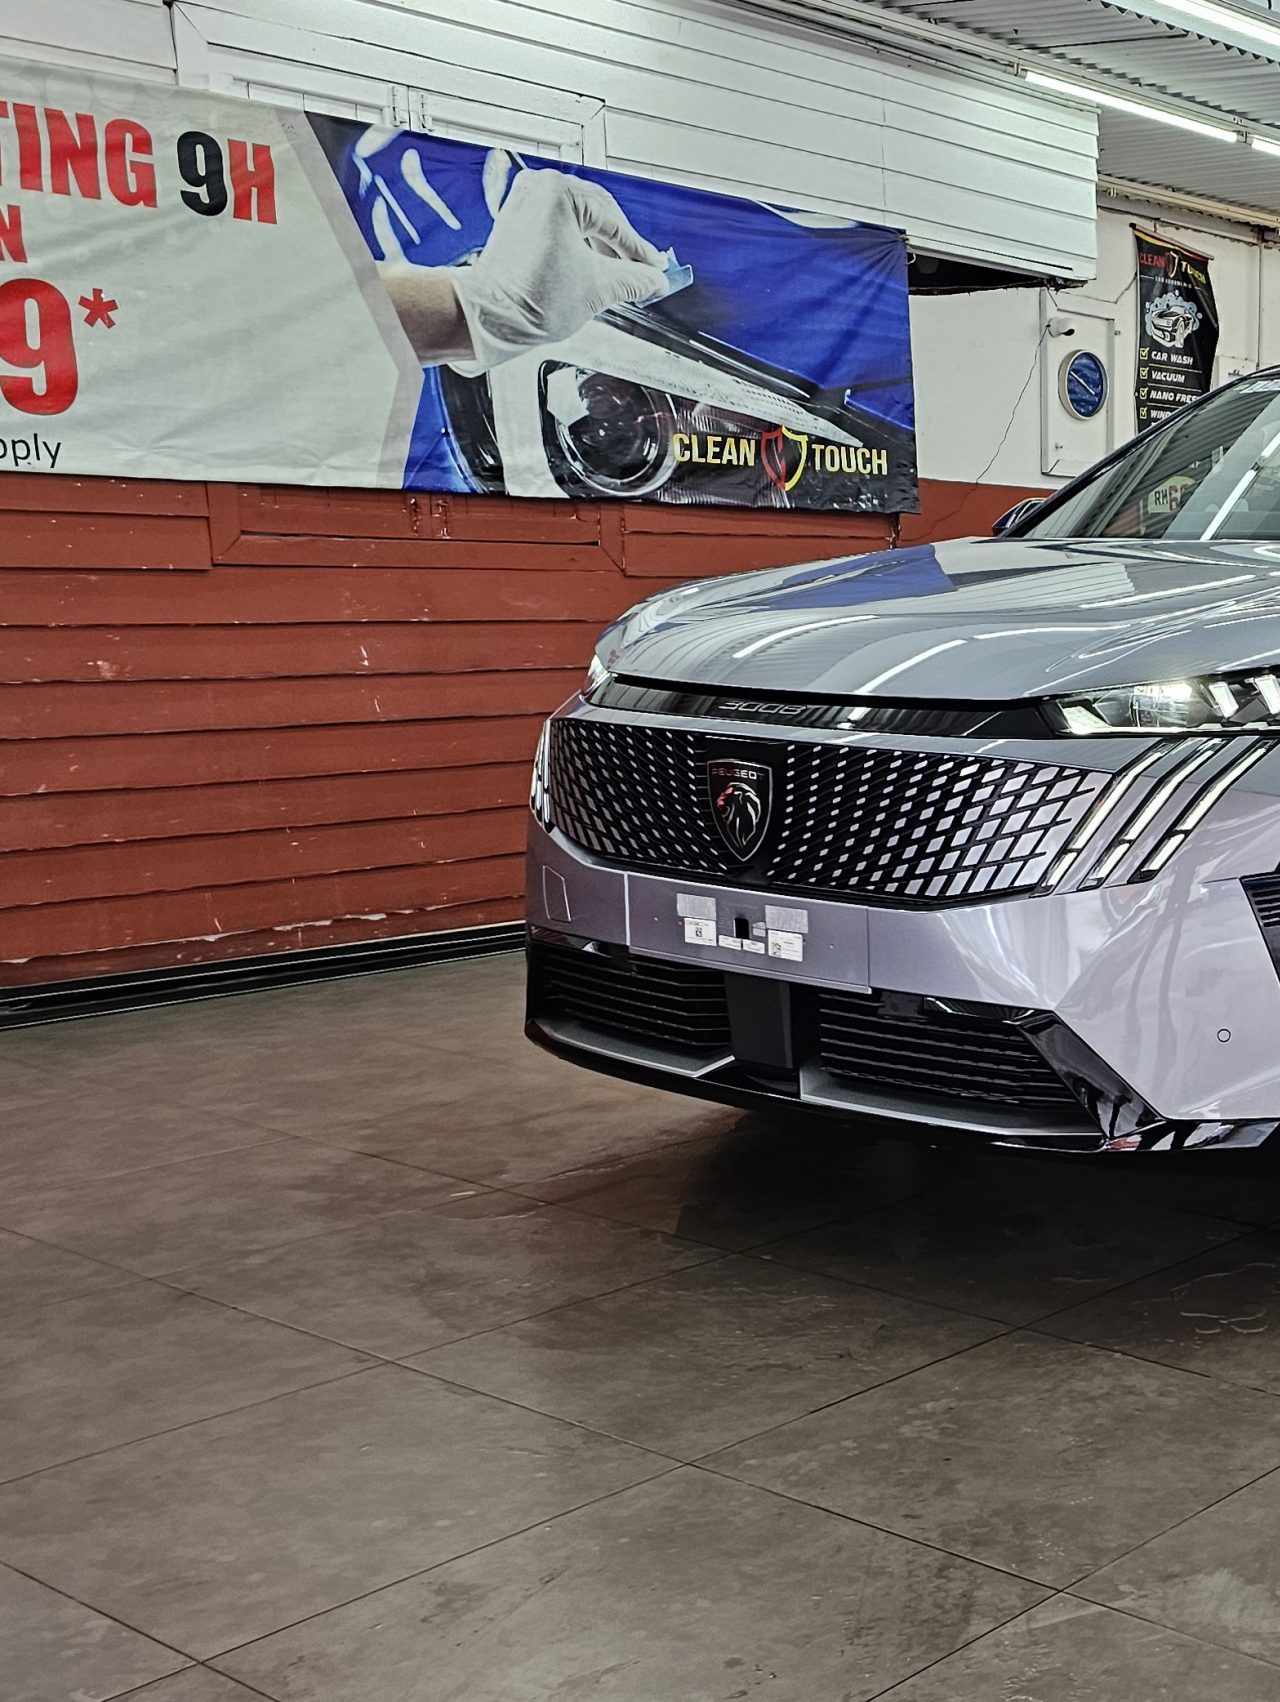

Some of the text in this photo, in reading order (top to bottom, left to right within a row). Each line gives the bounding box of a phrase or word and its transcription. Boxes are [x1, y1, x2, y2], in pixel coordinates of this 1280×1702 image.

[0, 101, 277, 224] ING 9H
[1151, 351, 1193, 365] CAR WASH
[1151, 370, 1185, 383] VACUUM
[1150, 390, 1174, 400] NANO
[673, 433, 888, 475] CLEAN TOUCH
[718, 701, 807, 715] 3008
